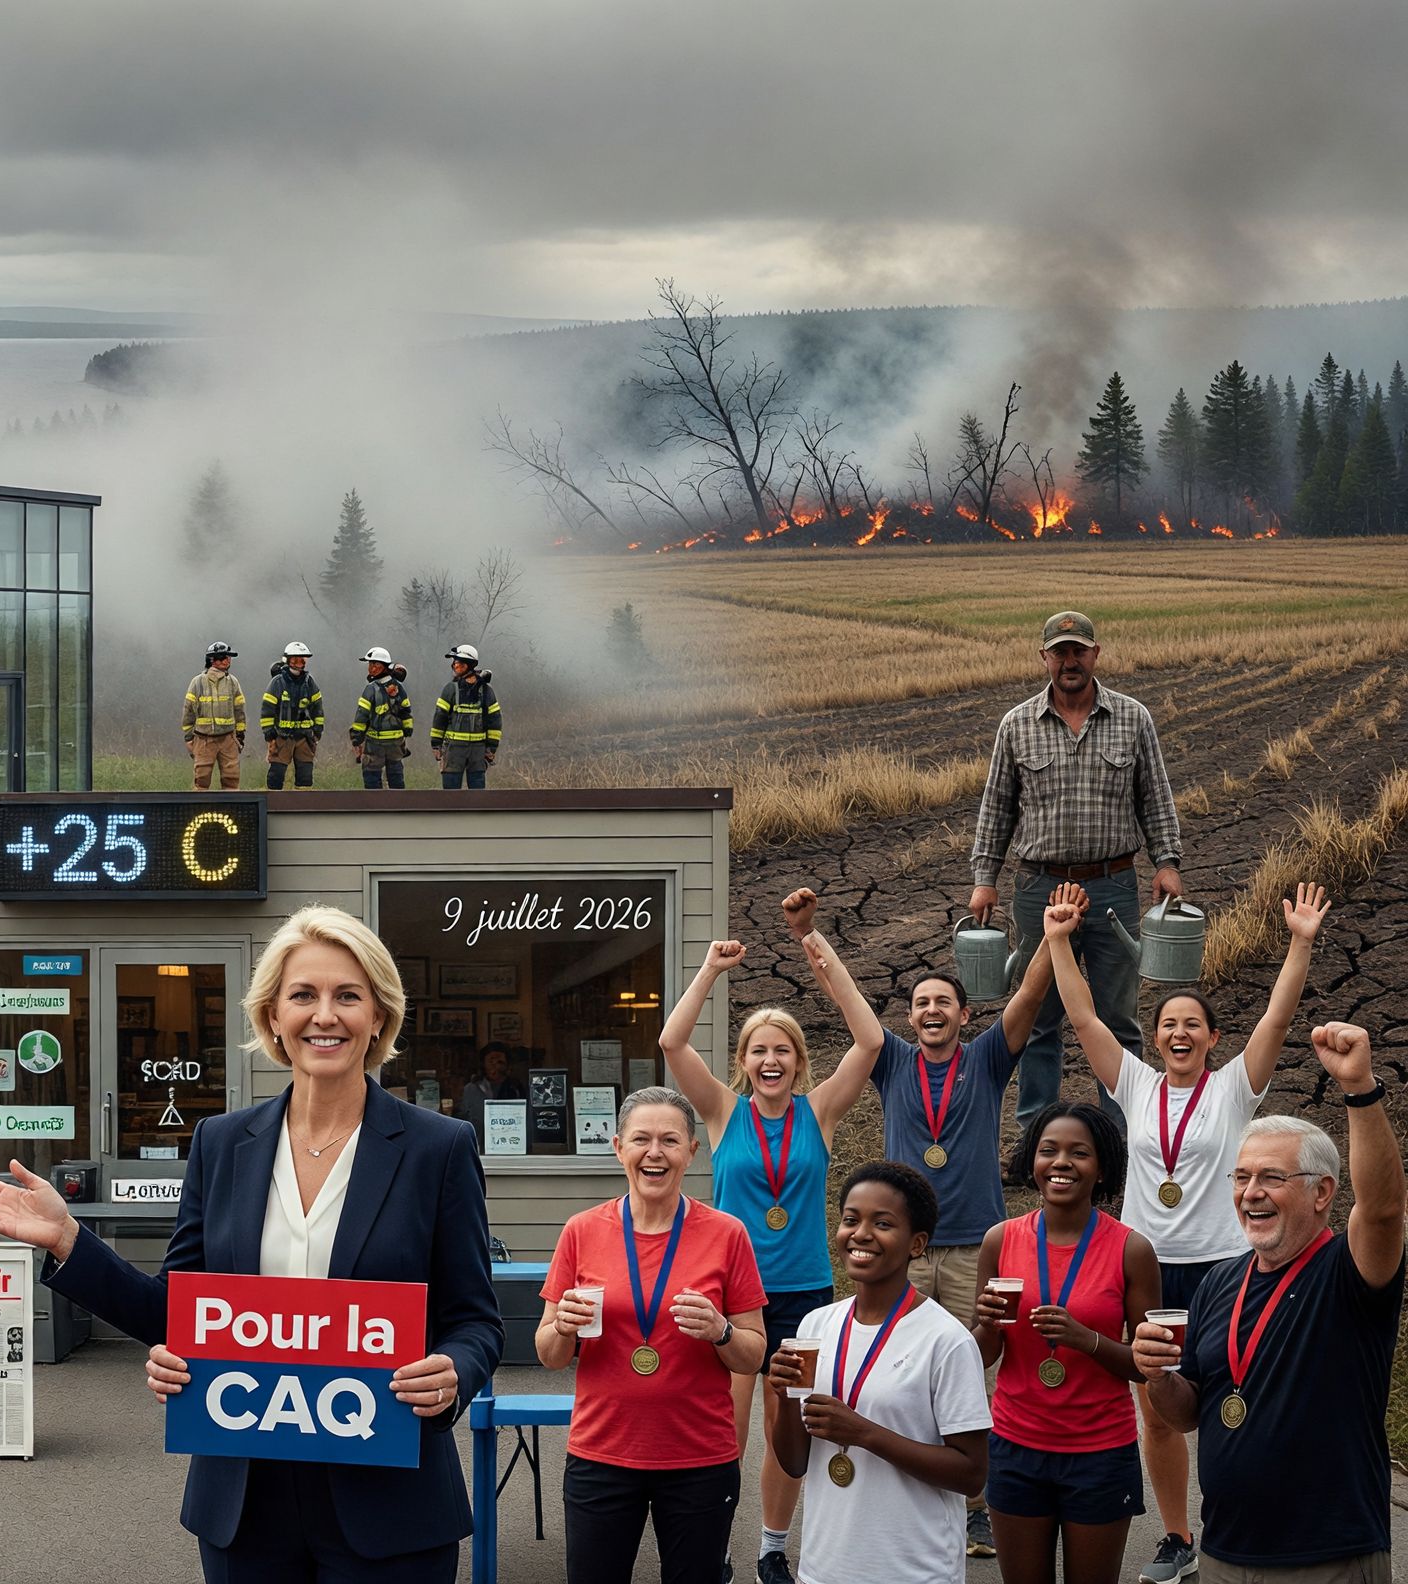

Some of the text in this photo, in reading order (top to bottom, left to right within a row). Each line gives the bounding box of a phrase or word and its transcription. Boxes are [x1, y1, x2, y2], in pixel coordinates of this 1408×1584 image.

[6, 811, 239, 882] +25 C
[441, 892, 653, 946] 9 juillet 2026
[194, 1296, 395, 1355] Pour la
[205, 1370, 377, 1441] CAQ
